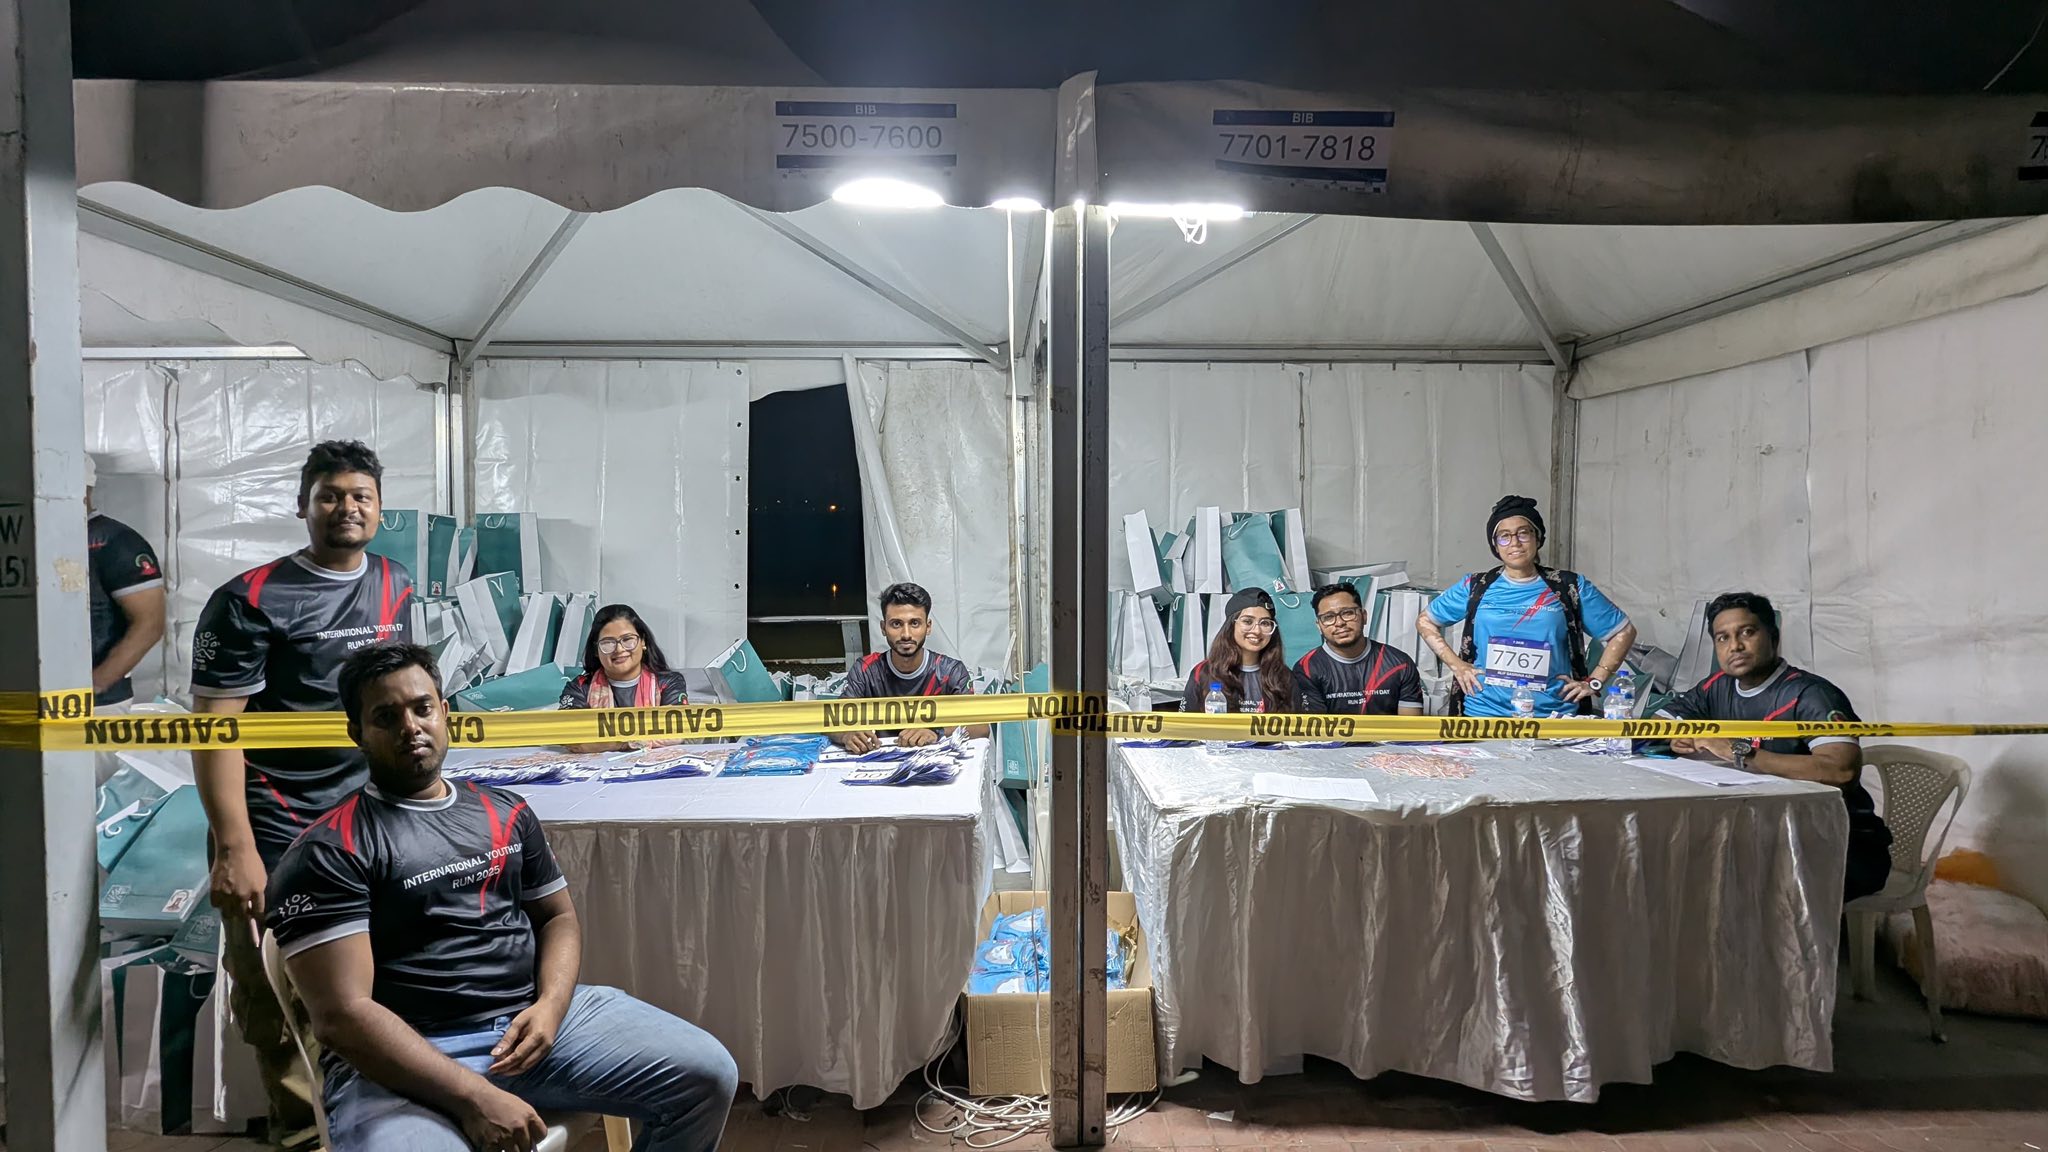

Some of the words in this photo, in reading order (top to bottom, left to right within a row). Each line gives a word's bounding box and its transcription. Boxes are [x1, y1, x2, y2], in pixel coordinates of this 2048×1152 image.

[855, 104, 877, 115] BIB
[1292, 112, 1314, 123] BIB
[782, 123, 942, 149] 7500-7600
[1219, 133, 1376, 161] 7701-7818
[347, 640, 365, 650] RUN
[1493, 649, 1543, 670] 7767
[598, 708, 722, 738] CAUTION
[823, 700, 937, 727] CAUTION
[84, 717, 239, 744] CAUTION
[1250, 715, 1355, 737] CAUTION
[1439, 719, 1541, 739] CAUTION
[404, 855, 486, 890] INTERNATIONAL
[485, 844, 515, 861] YOUTH
[452, 876, 475, 889] RUN
[476, 865, 501, 882] 2025
